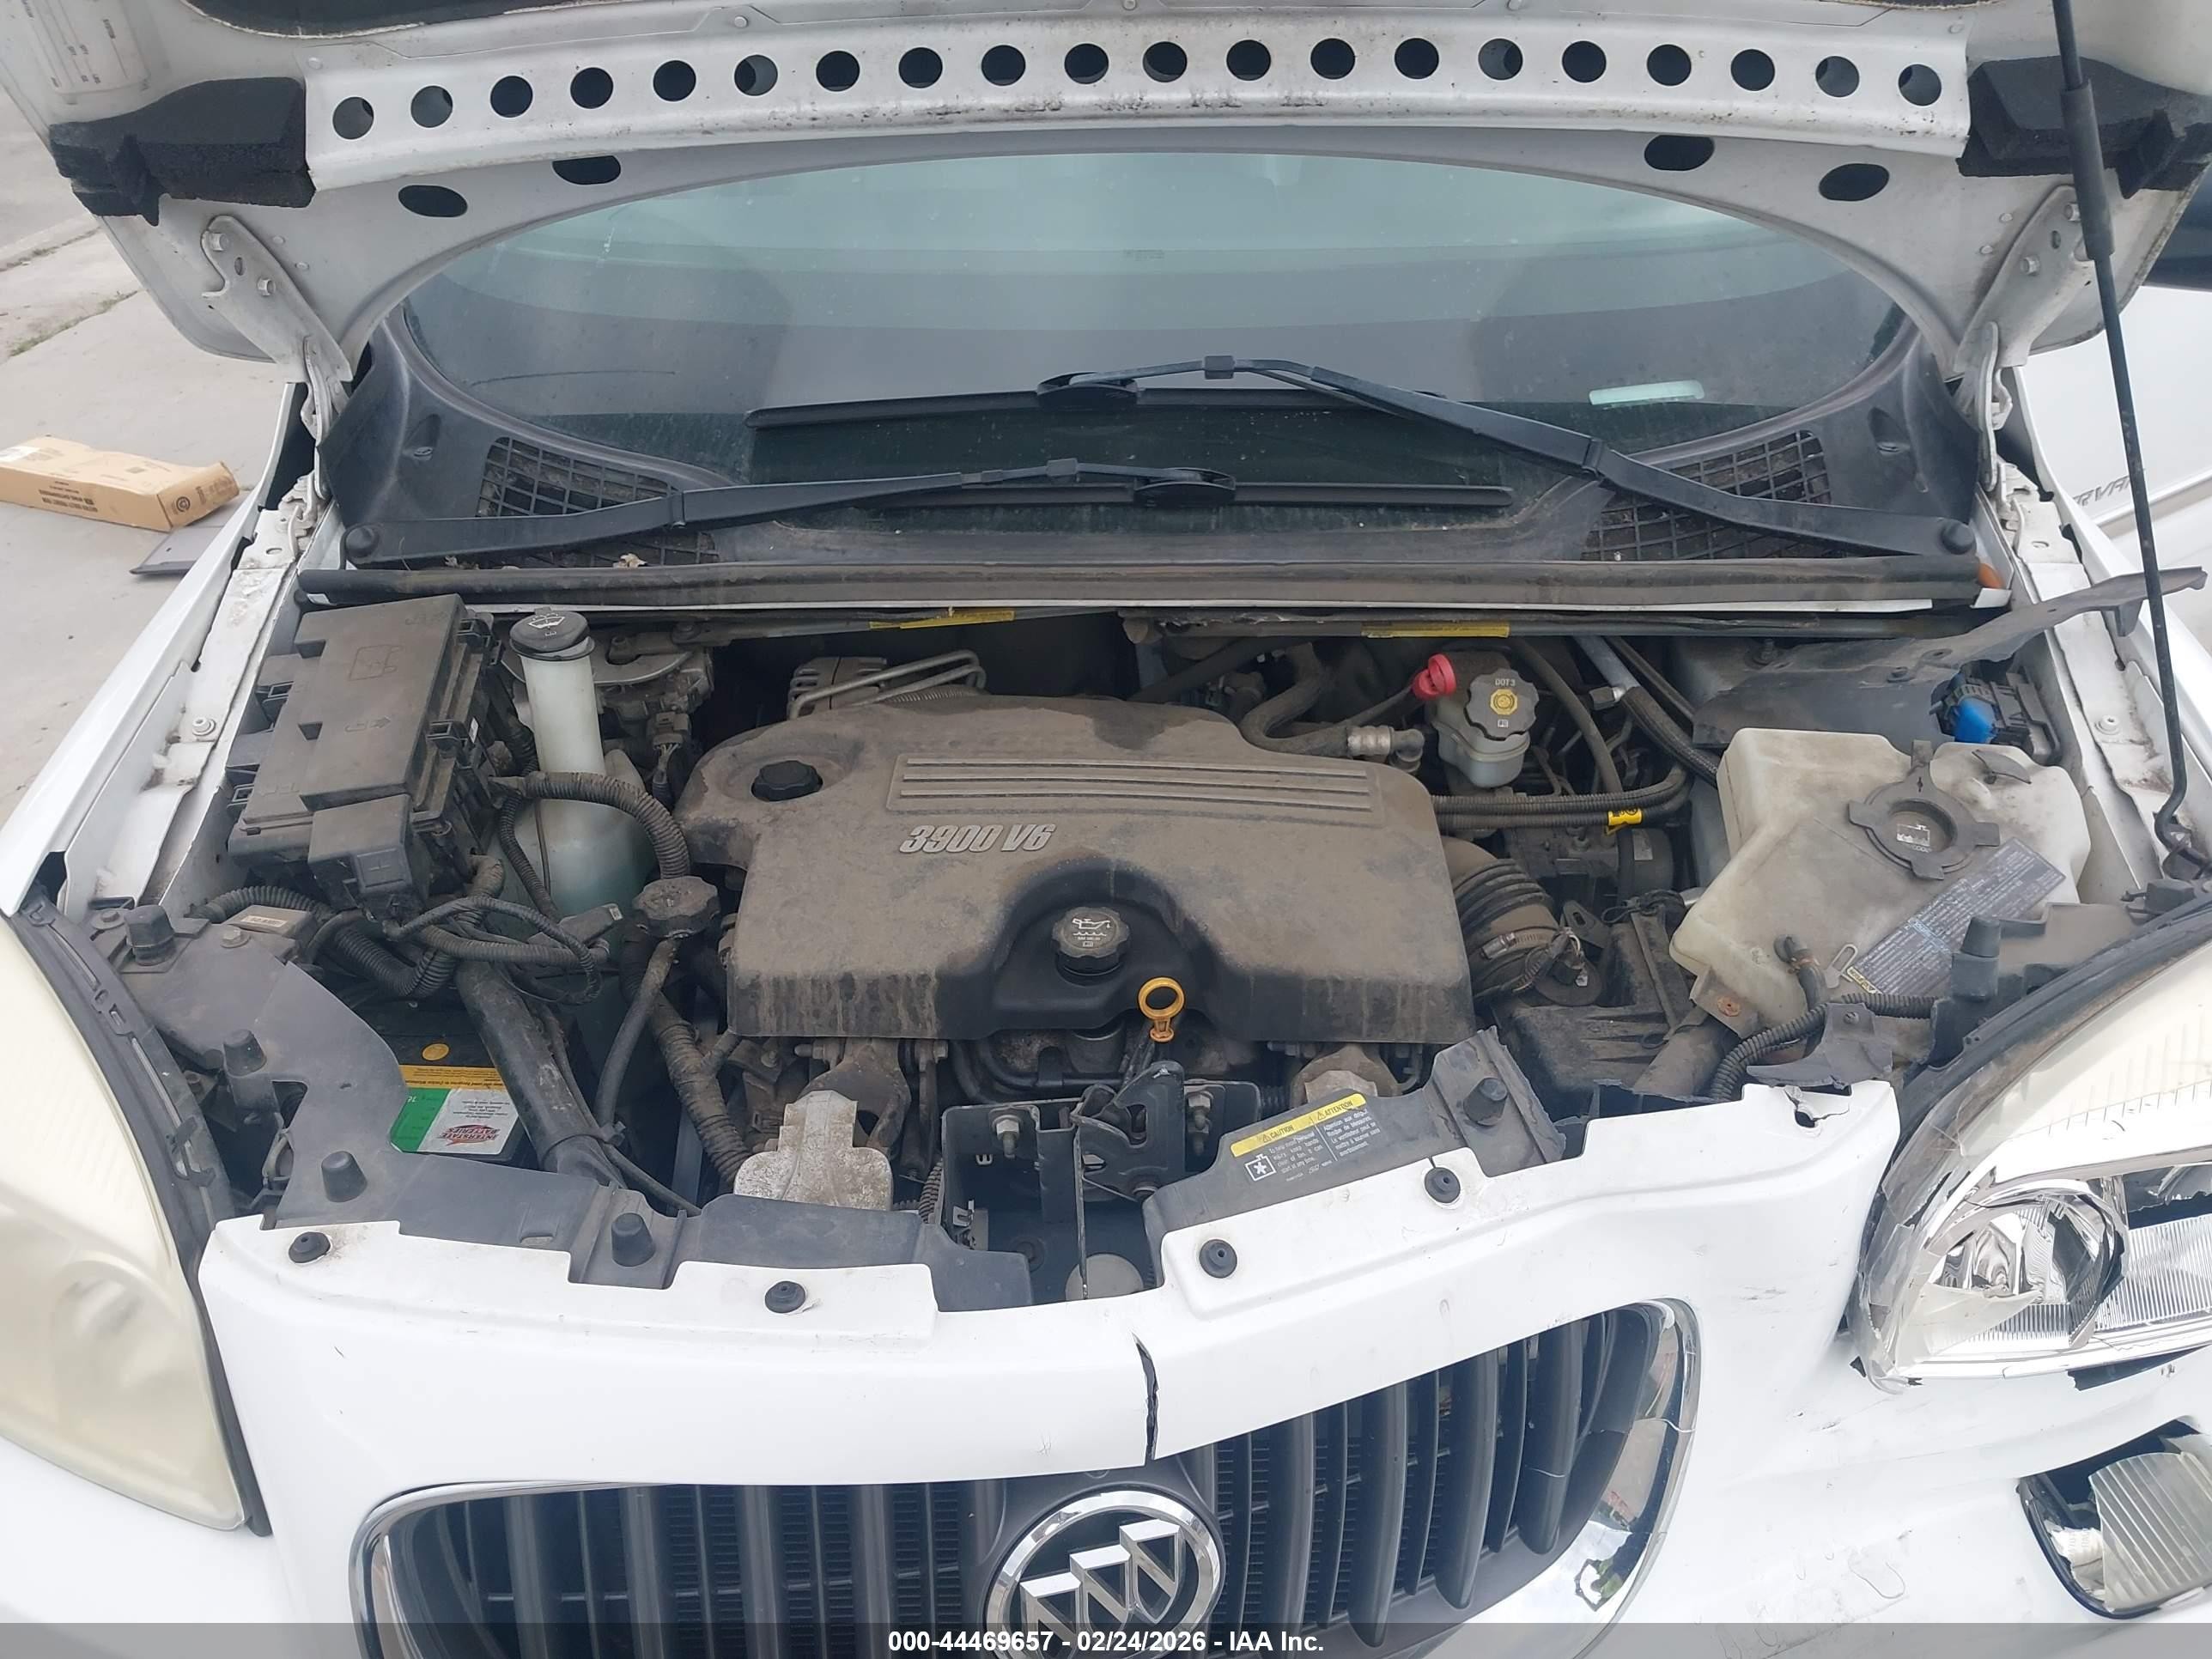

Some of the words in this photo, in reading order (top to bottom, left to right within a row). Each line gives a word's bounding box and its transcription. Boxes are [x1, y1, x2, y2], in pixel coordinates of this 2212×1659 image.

[900, 824, 1004, 854] 3900
[1000, 823, 1056, 852] V6
[1324, 1100, 1353, 1116] ATTENTION
[1269, 1125, 1294, 1139] CAUTION
